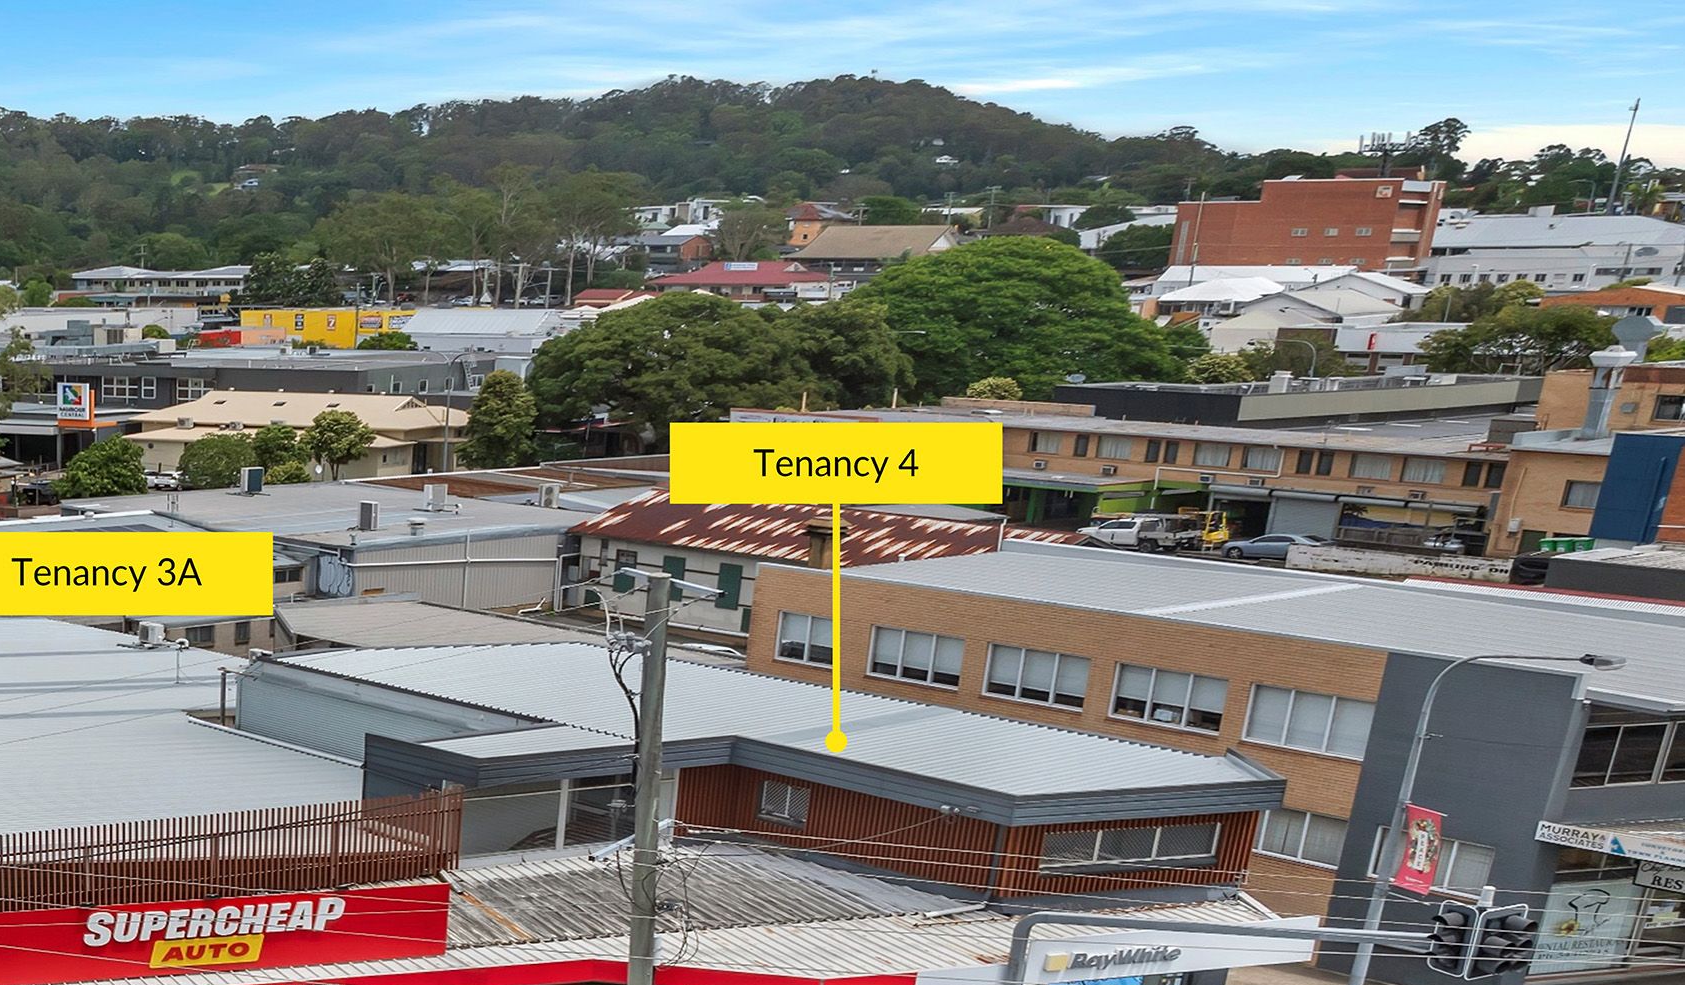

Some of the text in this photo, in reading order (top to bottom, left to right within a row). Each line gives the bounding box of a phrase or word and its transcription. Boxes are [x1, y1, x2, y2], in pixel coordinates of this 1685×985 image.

[1538, 833, 1605, 850] ASSOCIATES
[1539, 824, 1598, 841] MURRAY
[81, 896, 347, 948] SUPERCHEAP
[160, 942, 251, 963] AUTO
